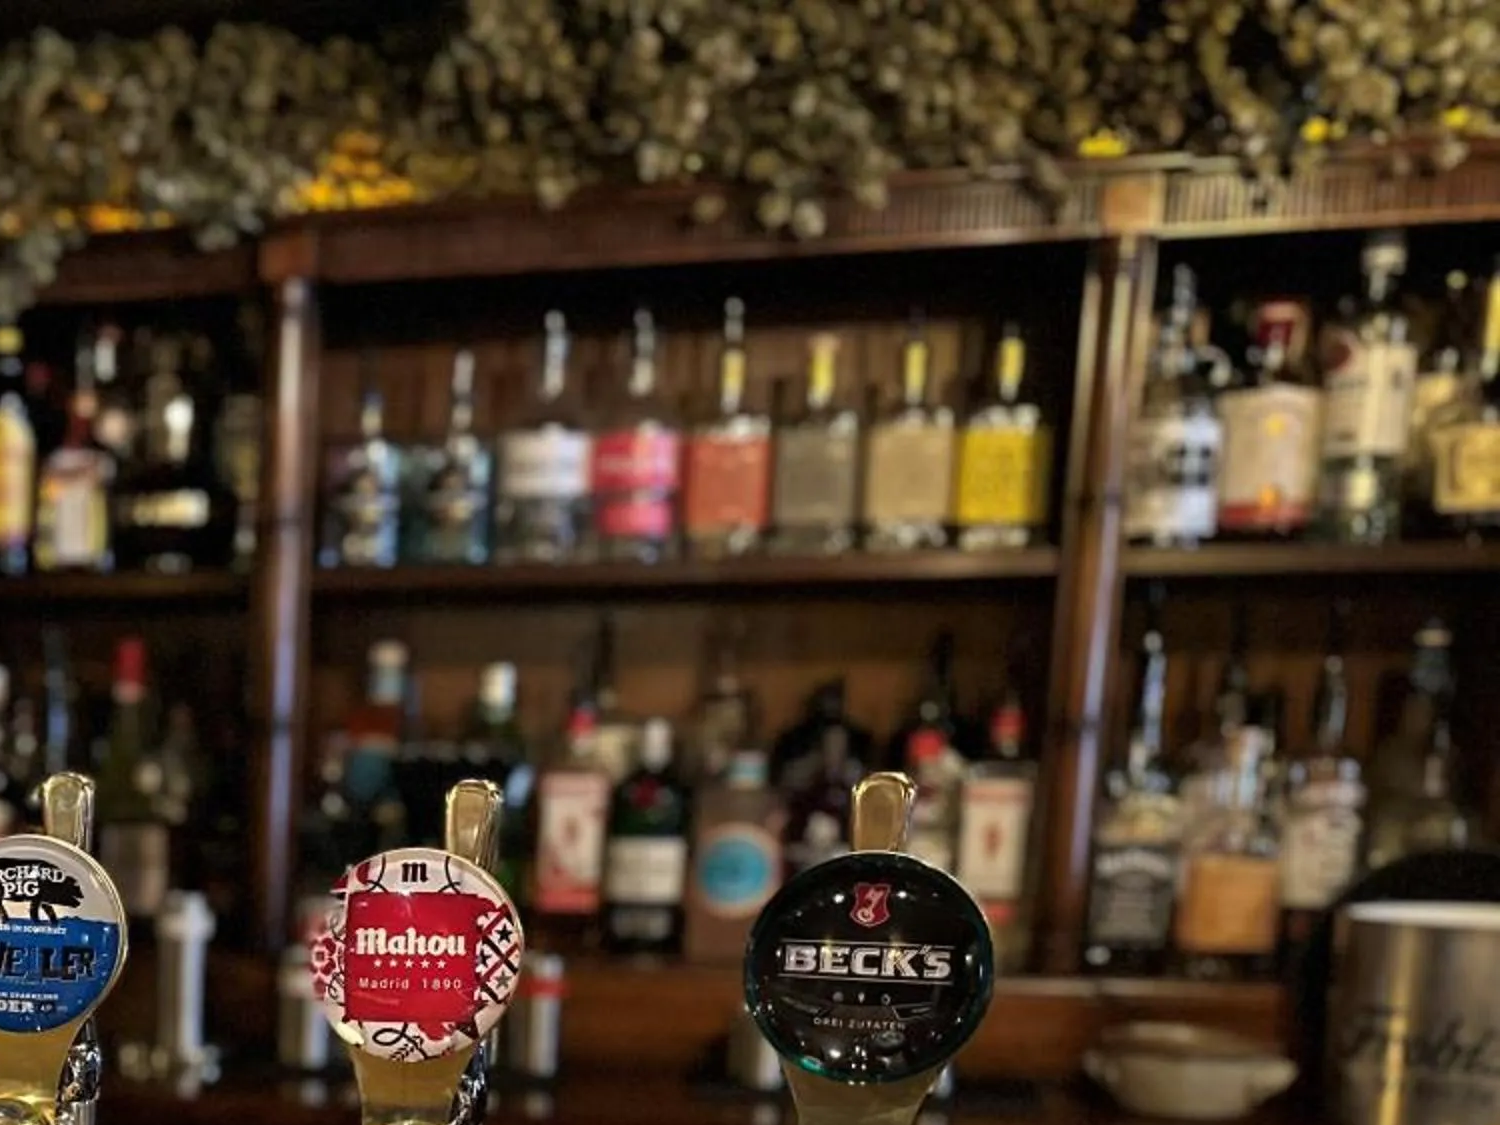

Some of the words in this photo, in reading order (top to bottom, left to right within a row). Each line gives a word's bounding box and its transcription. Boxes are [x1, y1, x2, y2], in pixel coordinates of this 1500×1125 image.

[3, 880, 40, 898] PIG
[355, 927, 466, 957] Mahou
[783, 945, 951, 980] BECK'S
[359, 977, 410, 990] Madrid
[421, 977, 462, 990] 1890
